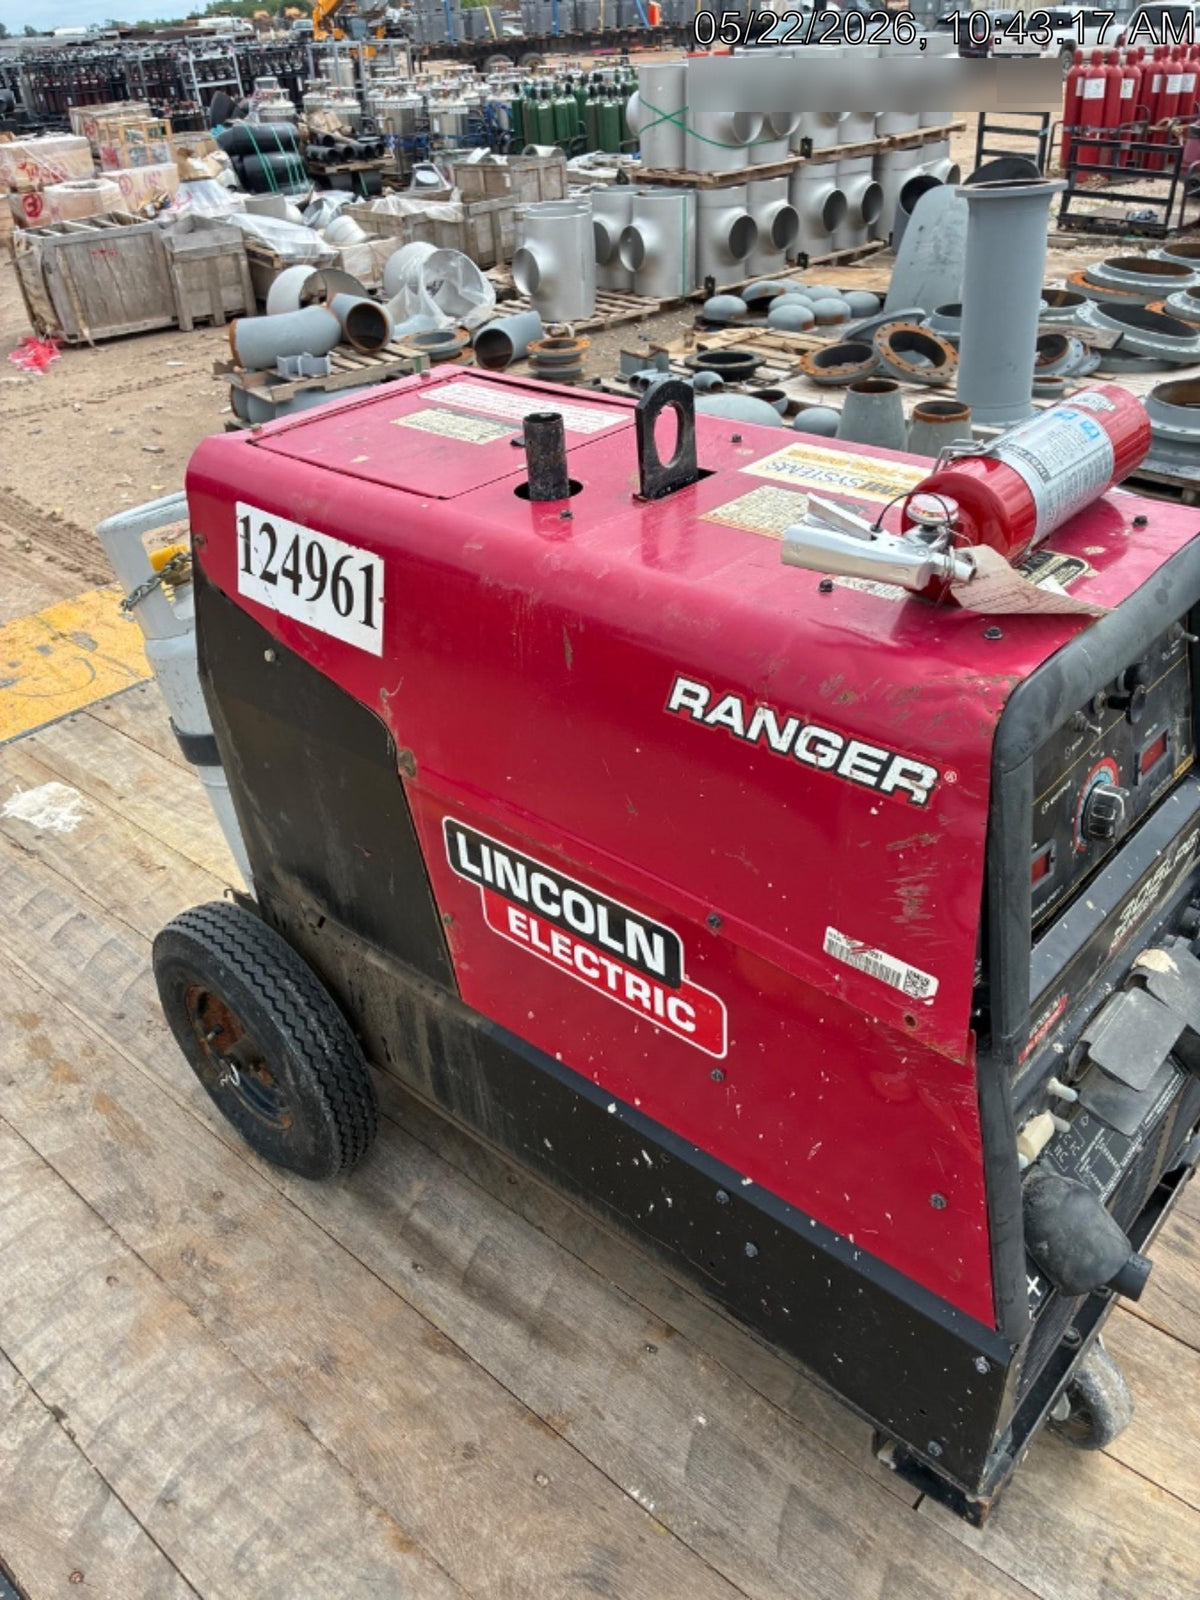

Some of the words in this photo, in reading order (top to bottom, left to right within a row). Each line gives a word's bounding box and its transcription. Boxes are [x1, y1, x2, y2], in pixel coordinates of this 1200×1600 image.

[239, 515, 377, 630] 124961
[667, 675, 940, 806] RANGER
[456, 831, 667, 977] LINCOLN
[507, 905, 696, 1033] ELECTRIC
